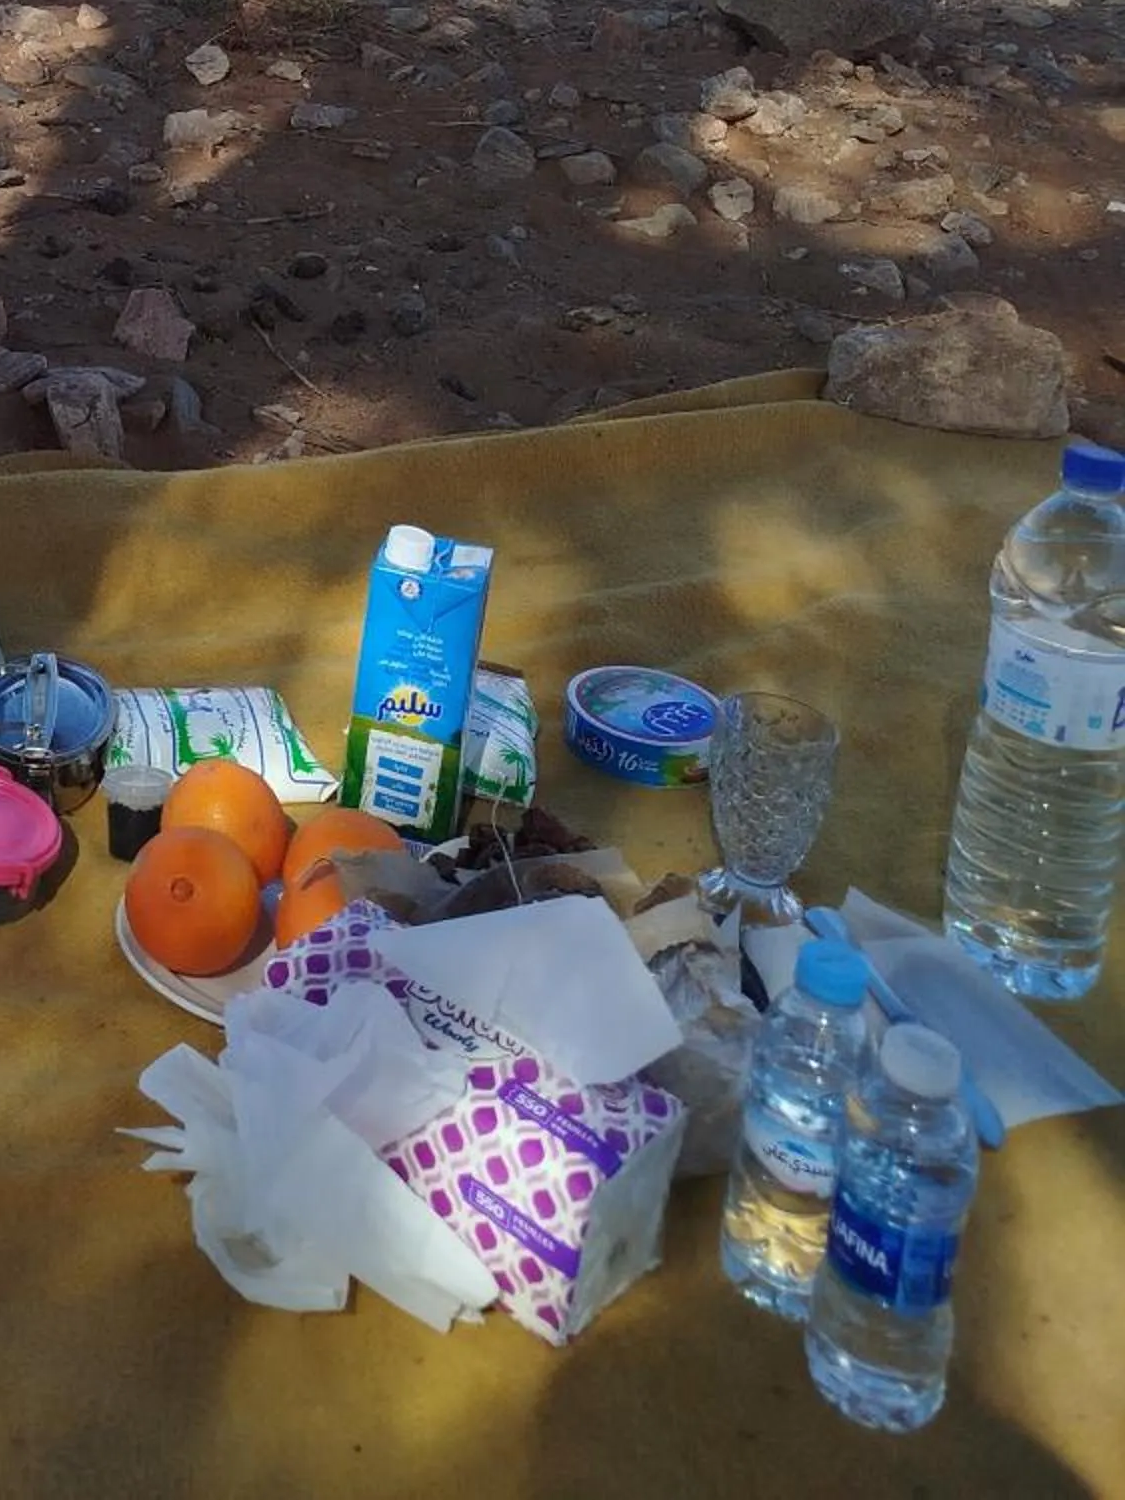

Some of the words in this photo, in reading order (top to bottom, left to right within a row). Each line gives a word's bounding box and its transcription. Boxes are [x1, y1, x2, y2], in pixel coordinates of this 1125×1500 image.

[378, 691, 441, 721] سليم
[618, 751, 638, 771] 16
[516, 1093, 547, 1117] 550
